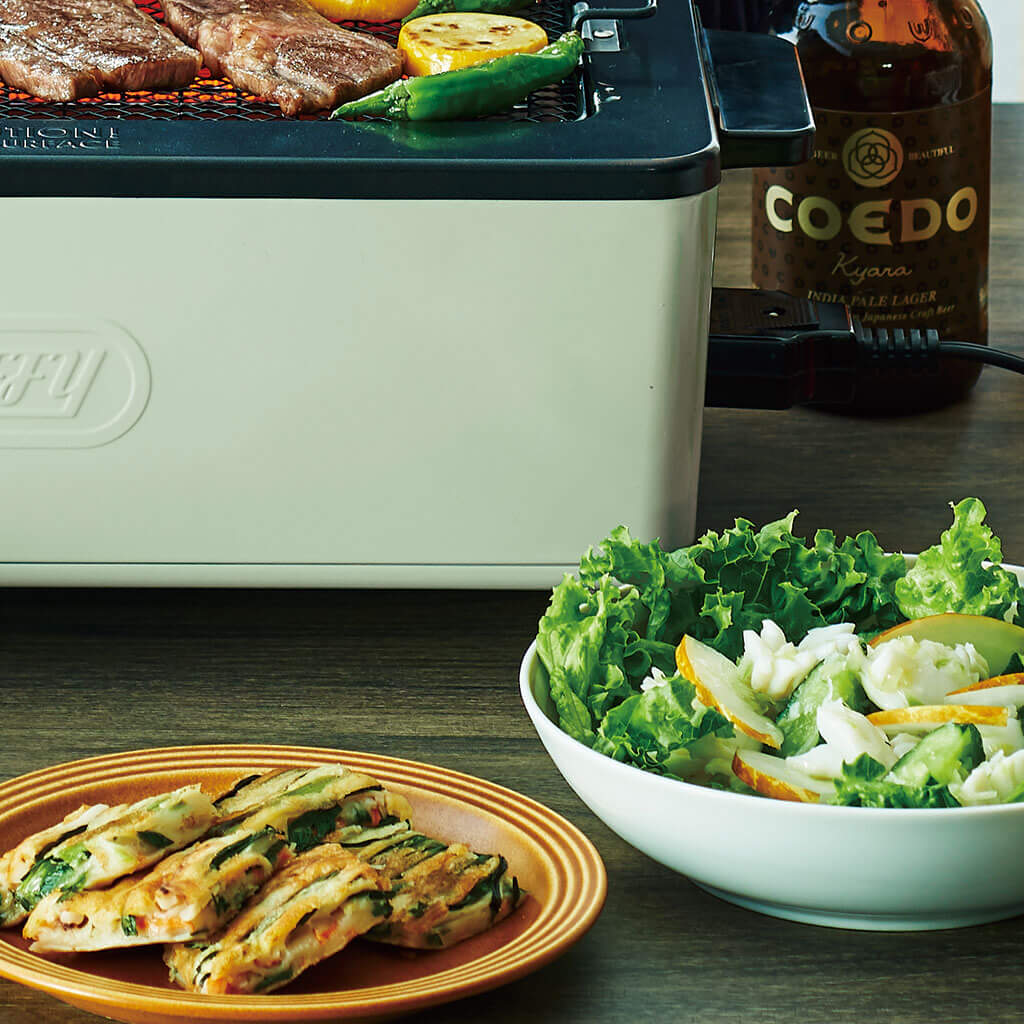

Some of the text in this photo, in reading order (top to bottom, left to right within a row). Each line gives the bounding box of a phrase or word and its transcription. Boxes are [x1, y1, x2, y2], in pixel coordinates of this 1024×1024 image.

[765, 184, 978, 246] COEDO
[831, 251, 913, 286] Kyara
[807, 289, 937, 307] INDIA PALE LAGER
